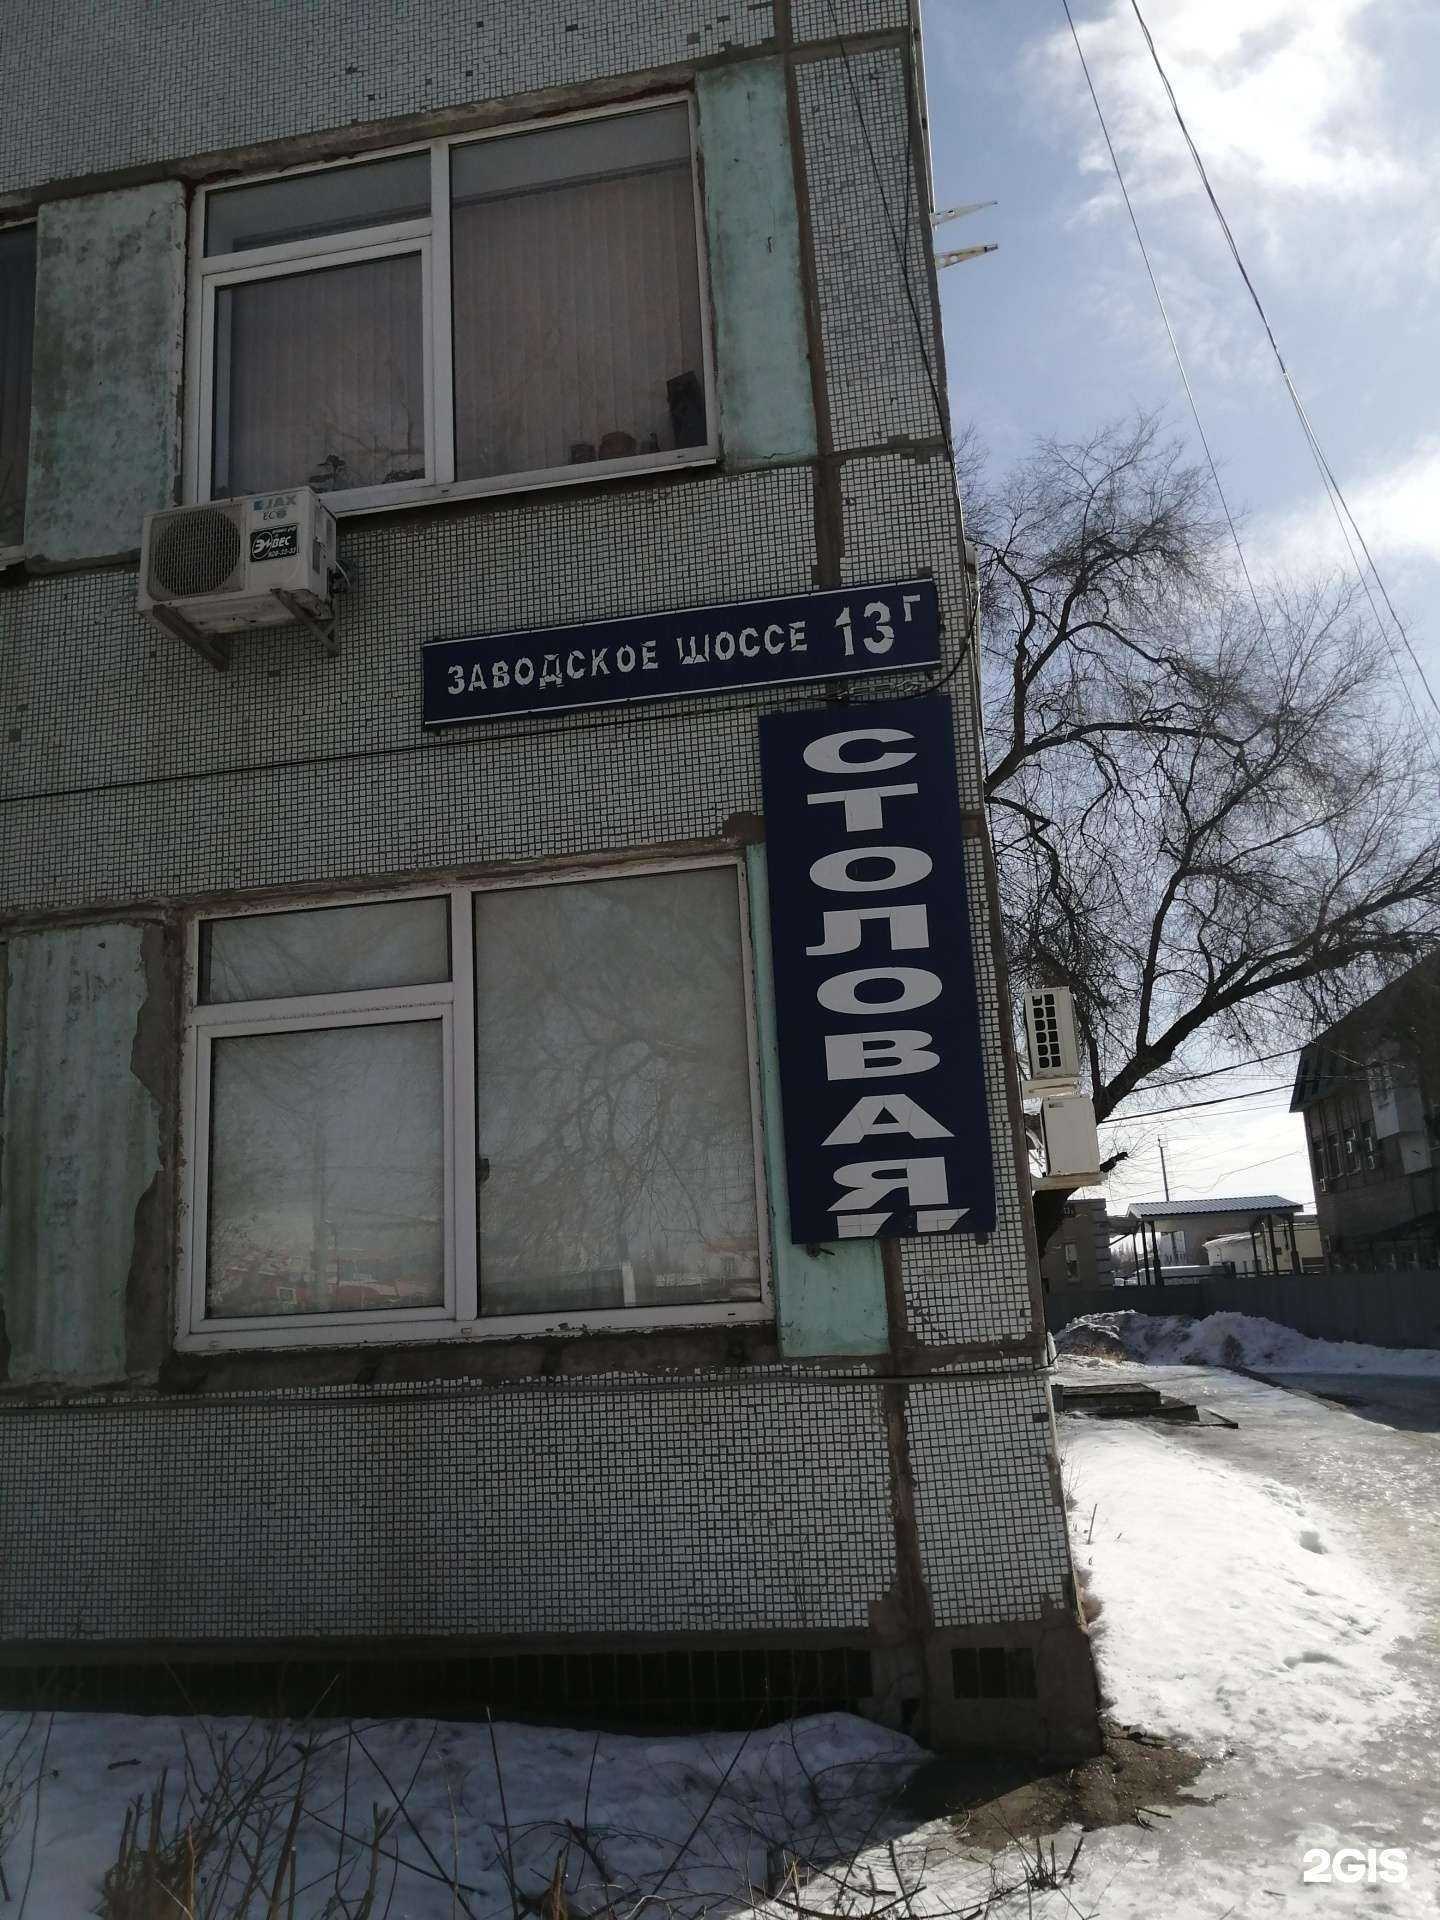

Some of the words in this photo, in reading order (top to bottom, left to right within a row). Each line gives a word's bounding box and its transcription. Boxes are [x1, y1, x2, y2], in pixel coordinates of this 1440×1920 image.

[446, 640, 659, 696] ЗАВОДСКОЕ
[676, 619, 809, 666] ШОССЕ
[802, 728, 956, 1212] СТОЛОВАЯ
